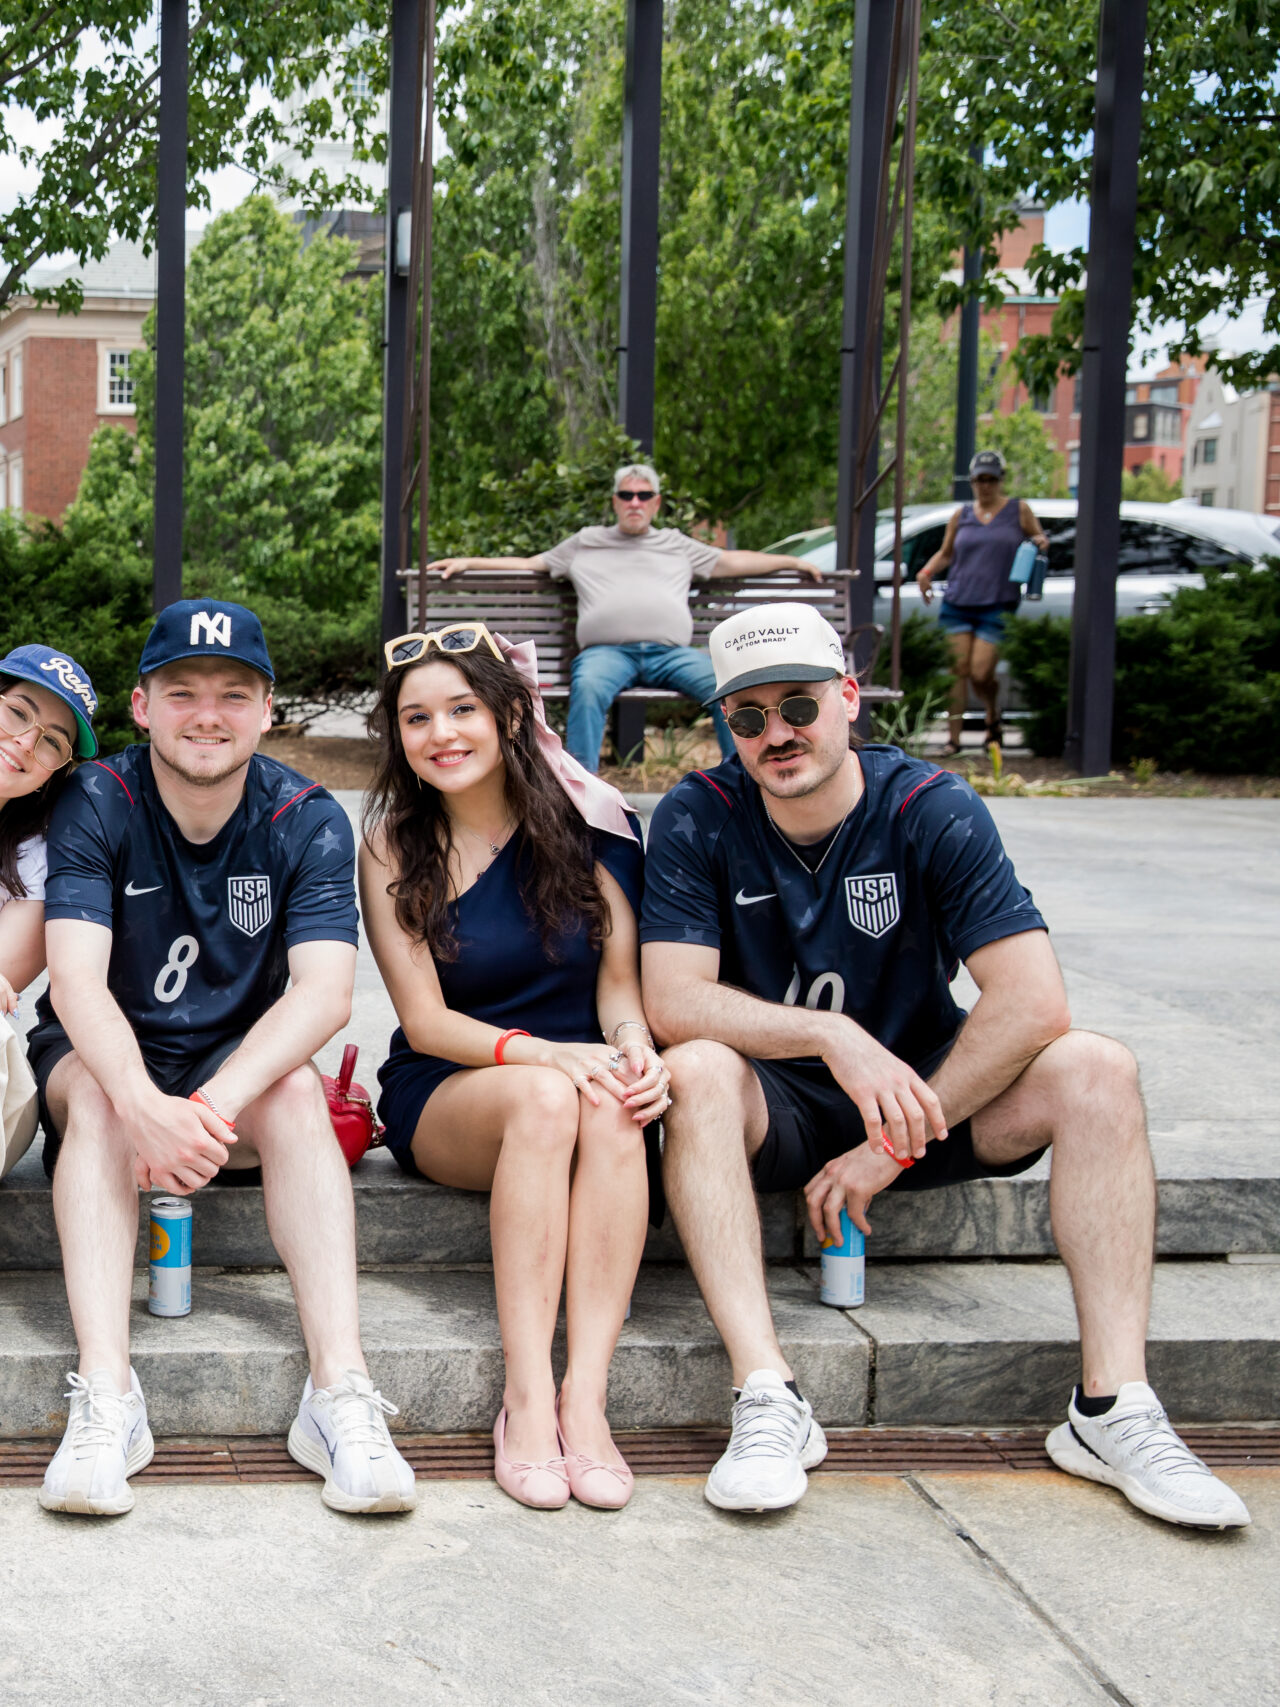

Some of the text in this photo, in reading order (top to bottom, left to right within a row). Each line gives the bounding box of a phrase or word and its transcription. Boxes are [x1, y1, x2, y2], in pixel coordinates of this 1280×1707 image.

[189, 611, 232, 648] NY
[745, 639, 760, 647] TOM
[232, 880, 267, 903] USA
[850, 877, 892, 903] USA
[153, 934, 200, 1003] 8
